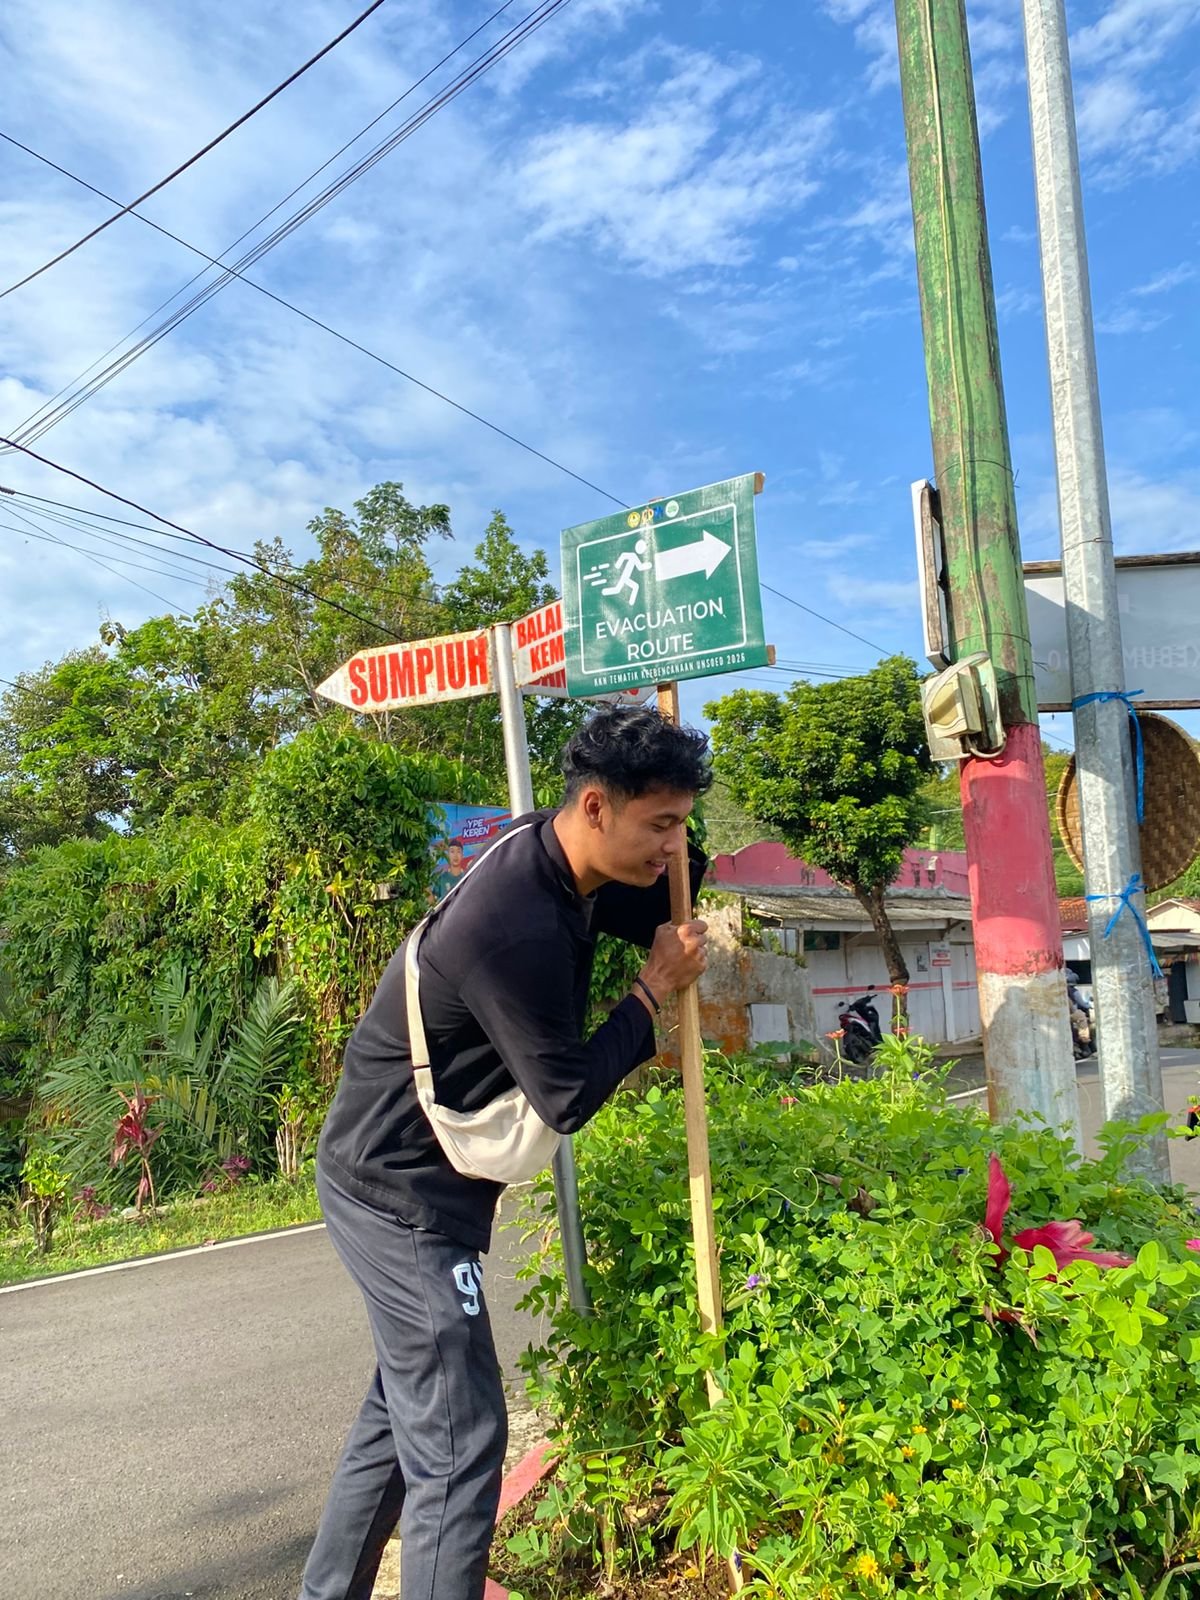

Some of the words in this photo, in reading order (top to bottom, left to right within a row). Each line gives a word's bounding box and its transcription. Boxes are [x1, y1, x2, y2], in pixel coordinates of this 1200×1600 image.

[517, 604, 562, 649] BALAI
[596, 597, 725, 640] EVACUATION
[627, 632, 694, 661] ROUTE
[348, 636, 488, 706] SUMPIUH
[609, 671, 639, 684] TEMATIK
[726, 652, 746, 665] 2026
[463, 824, 490, 838] KEREN
